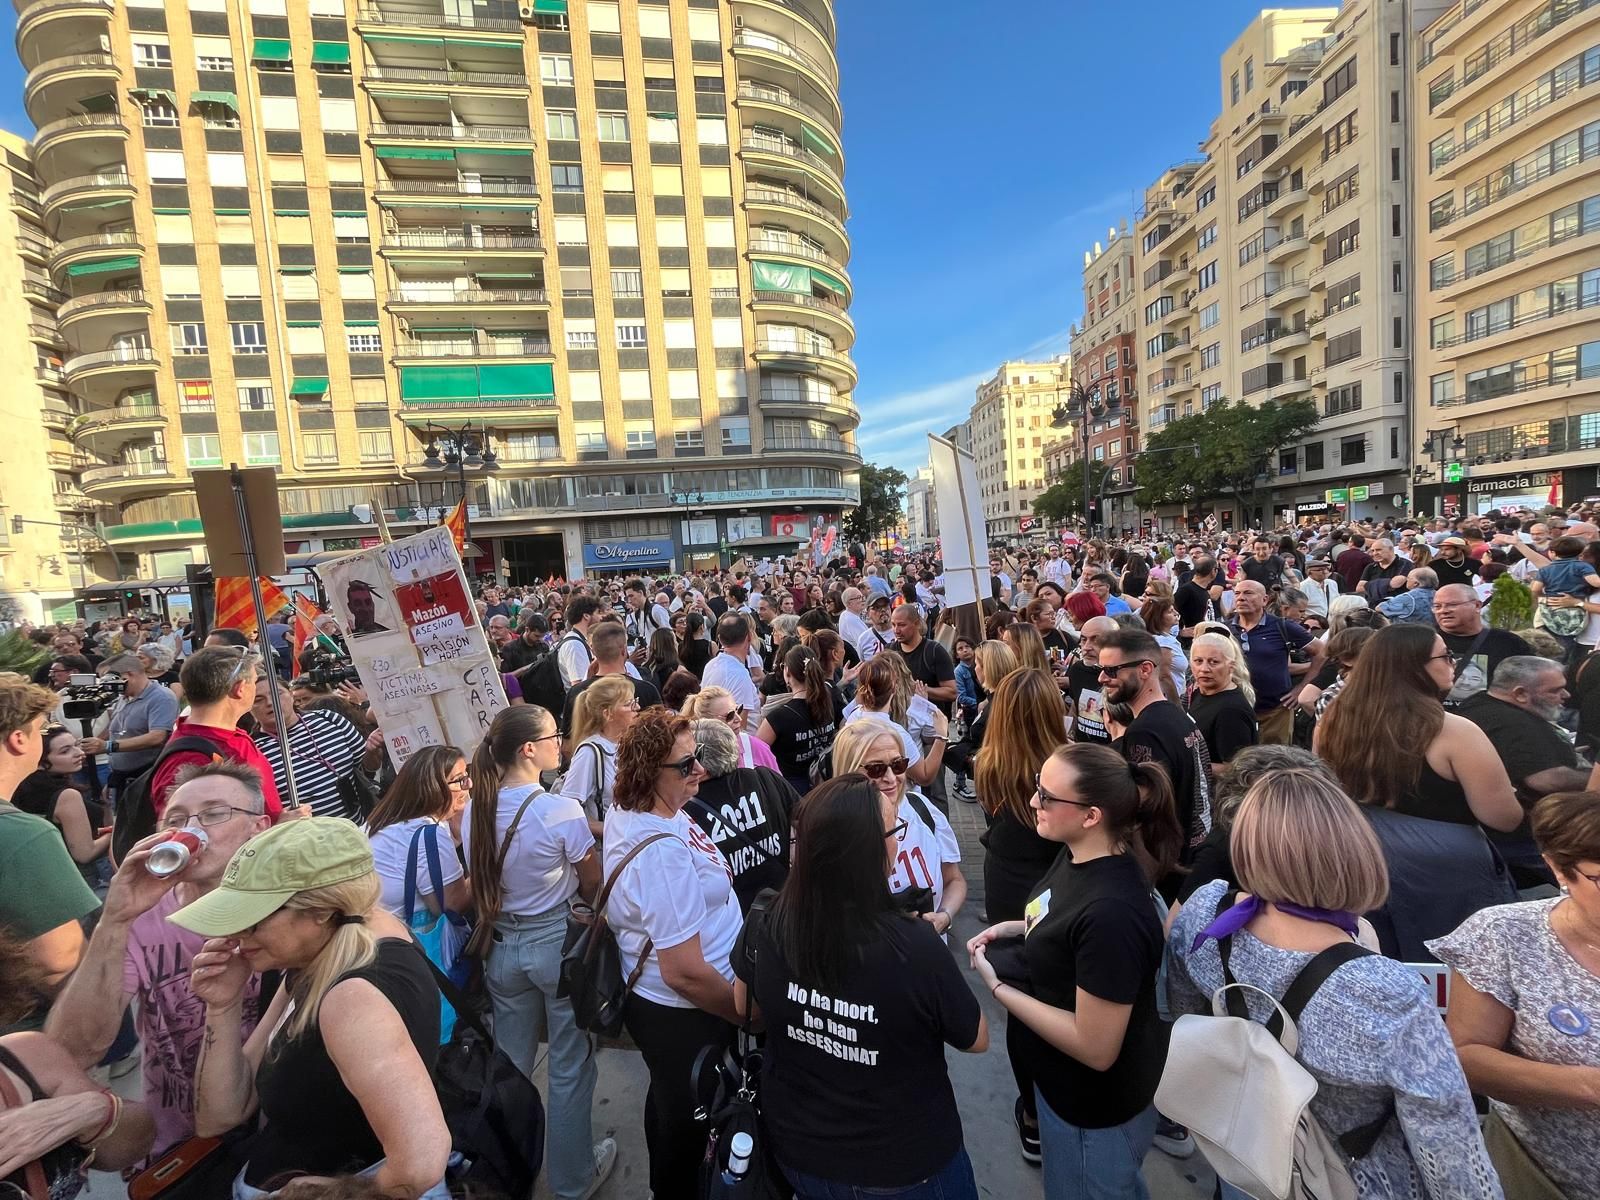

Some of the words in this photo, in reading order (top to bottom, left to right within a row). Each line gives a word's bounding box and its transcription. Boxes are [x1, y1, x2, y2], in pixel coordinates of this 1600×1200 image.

[1298, 503, 1328, 511] CALZEDO
[1021, 518, 1037, 529] CGT
[608, 545, 659, 561] Argentina
[411, 604, 448, 623] Mazón
[706, 791, 767, 844] 20:11
[787, 981, 808, 1005] No
[810, 989, 831, 1011] ha
[833, 998, 879, 1025] mort,
[803, 1010, 824, 1030] ho
[826, 1018, 858, 1042] han
[787, 1024, 879, 1066] ASSESSINAT
